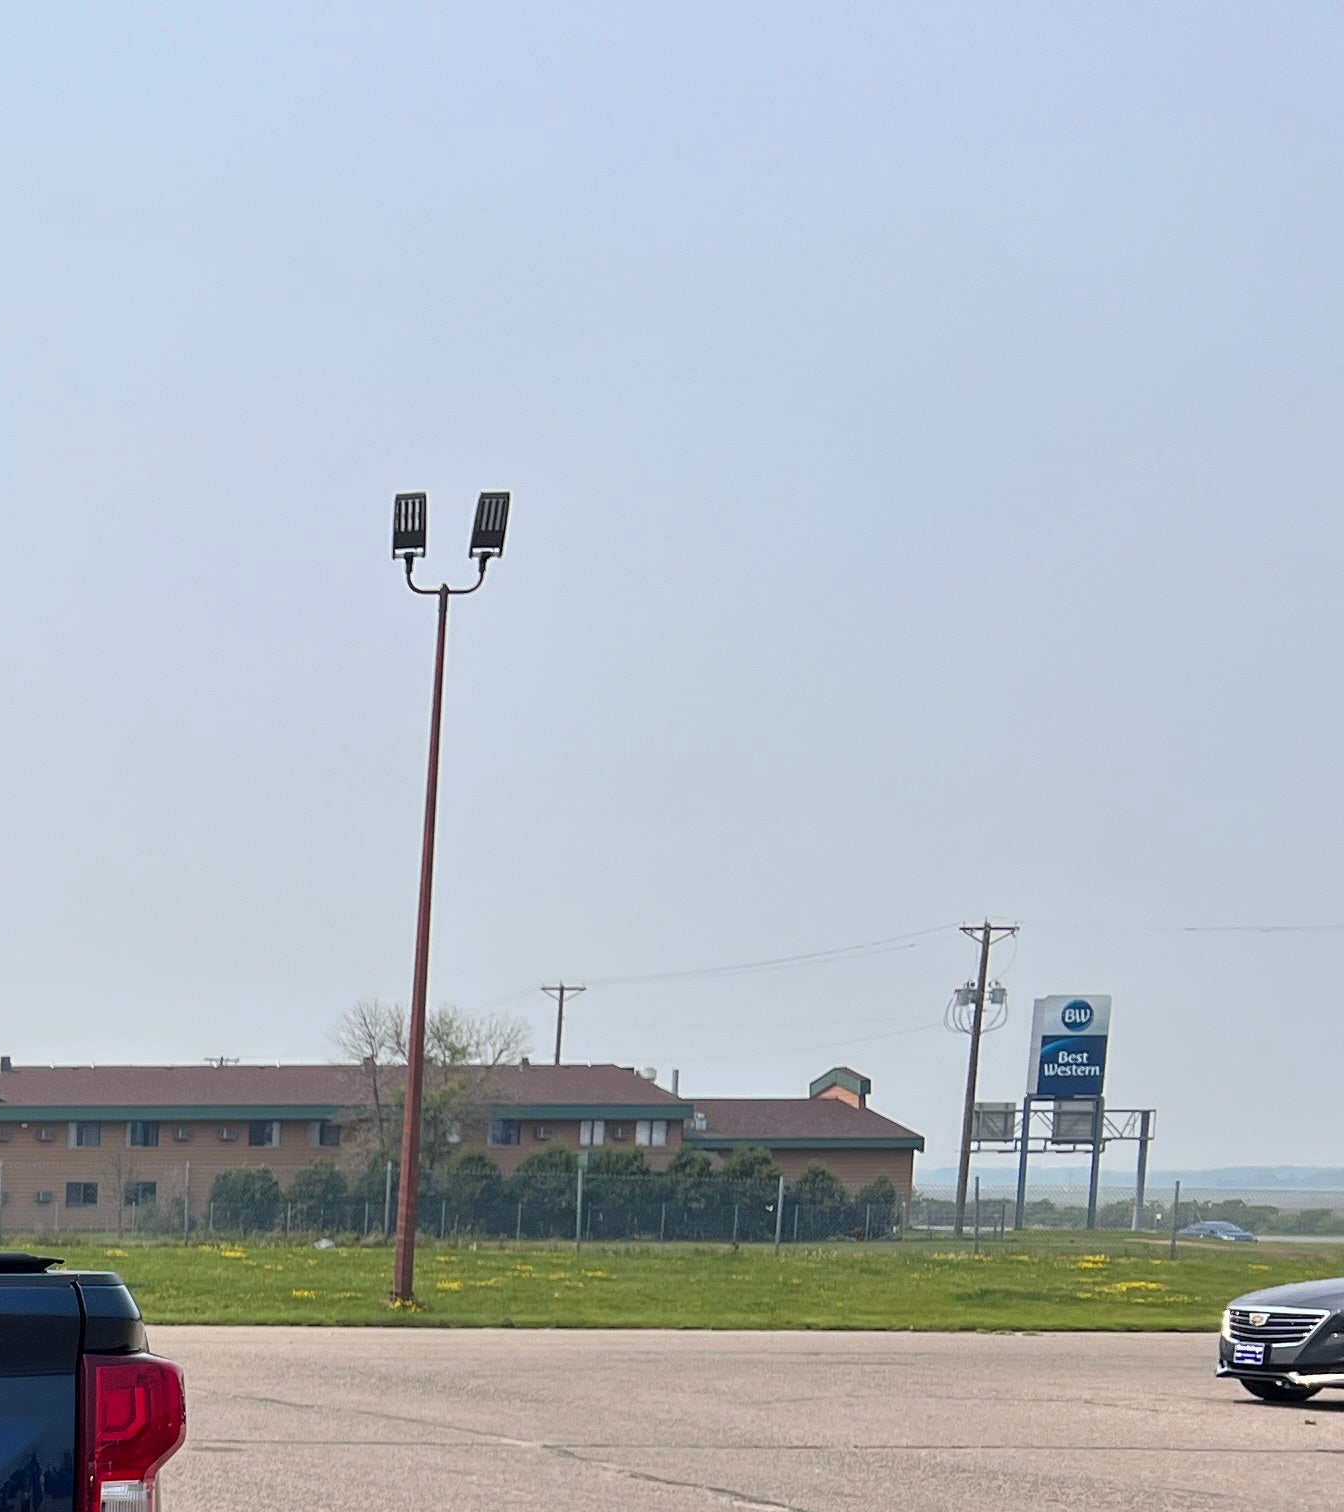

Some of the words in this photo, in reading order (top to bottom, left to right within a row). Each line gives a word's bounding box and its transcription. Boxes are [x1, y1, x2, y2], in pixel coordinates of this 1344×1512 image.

[1064, 1008, 1090, 1023] BW
[1058, 1051, 1089, 1064] Best
[1044, 1063, 1100, 1076] Western
